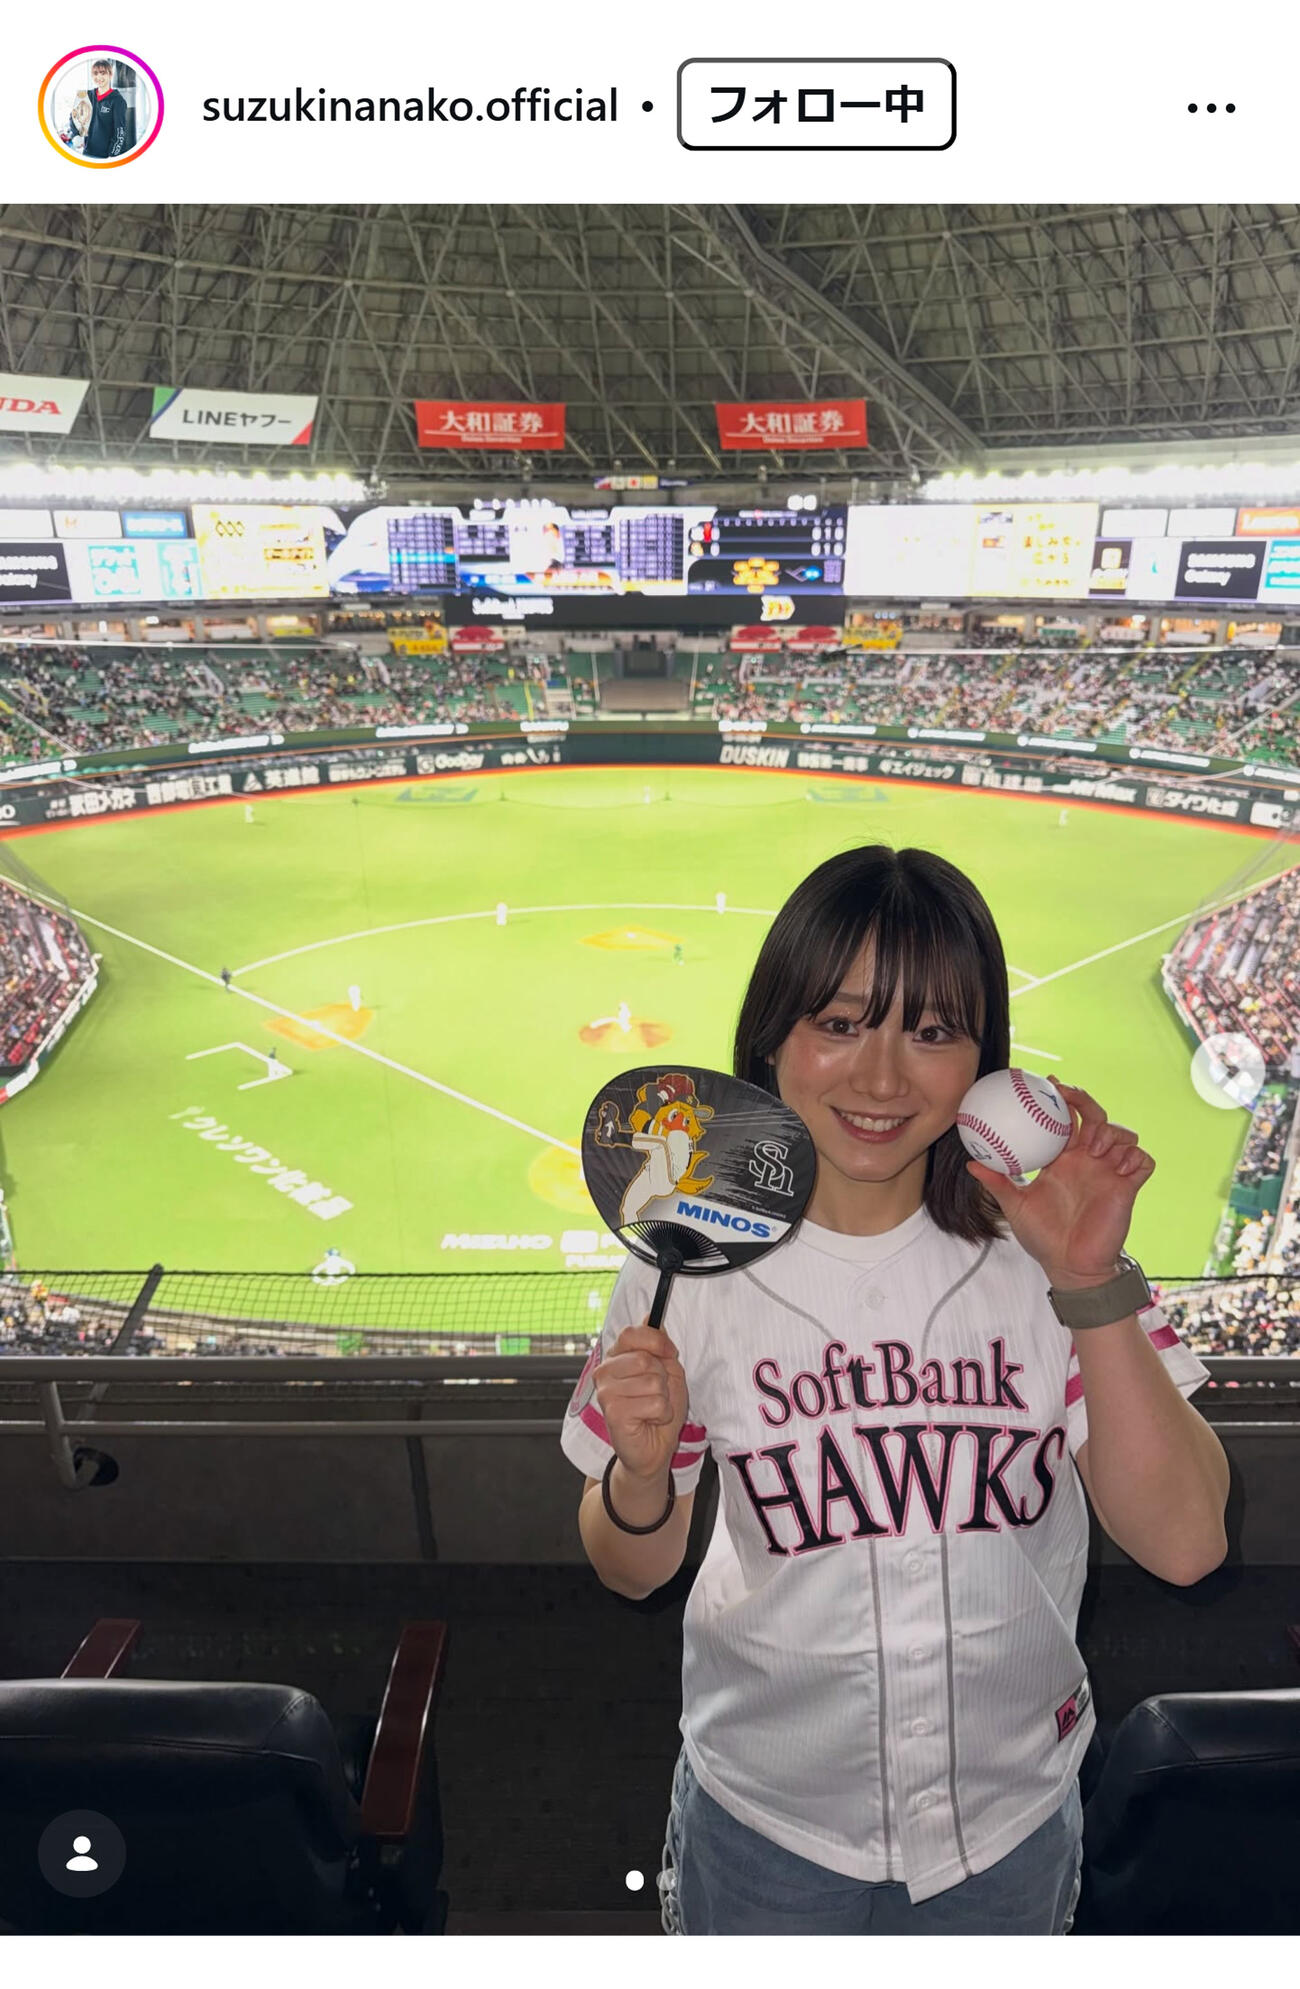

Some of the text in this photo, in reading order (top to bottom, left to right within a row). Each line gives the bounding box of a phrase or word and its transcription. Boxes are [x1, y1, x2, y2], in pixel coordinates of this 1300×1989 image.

[182, 409, 291, 428] LINEヤフー
[440, 409, 543, 433] 大和証券
[739, 410, 844, 433] 大和証券
[719, 745, 790, 768] DUSKIN
[676, 1201, 771, 1238] MINOS
[753, 1337, 1029, 1428] SoftBank
[727, 1421, 1067, 1557] HAWKS
